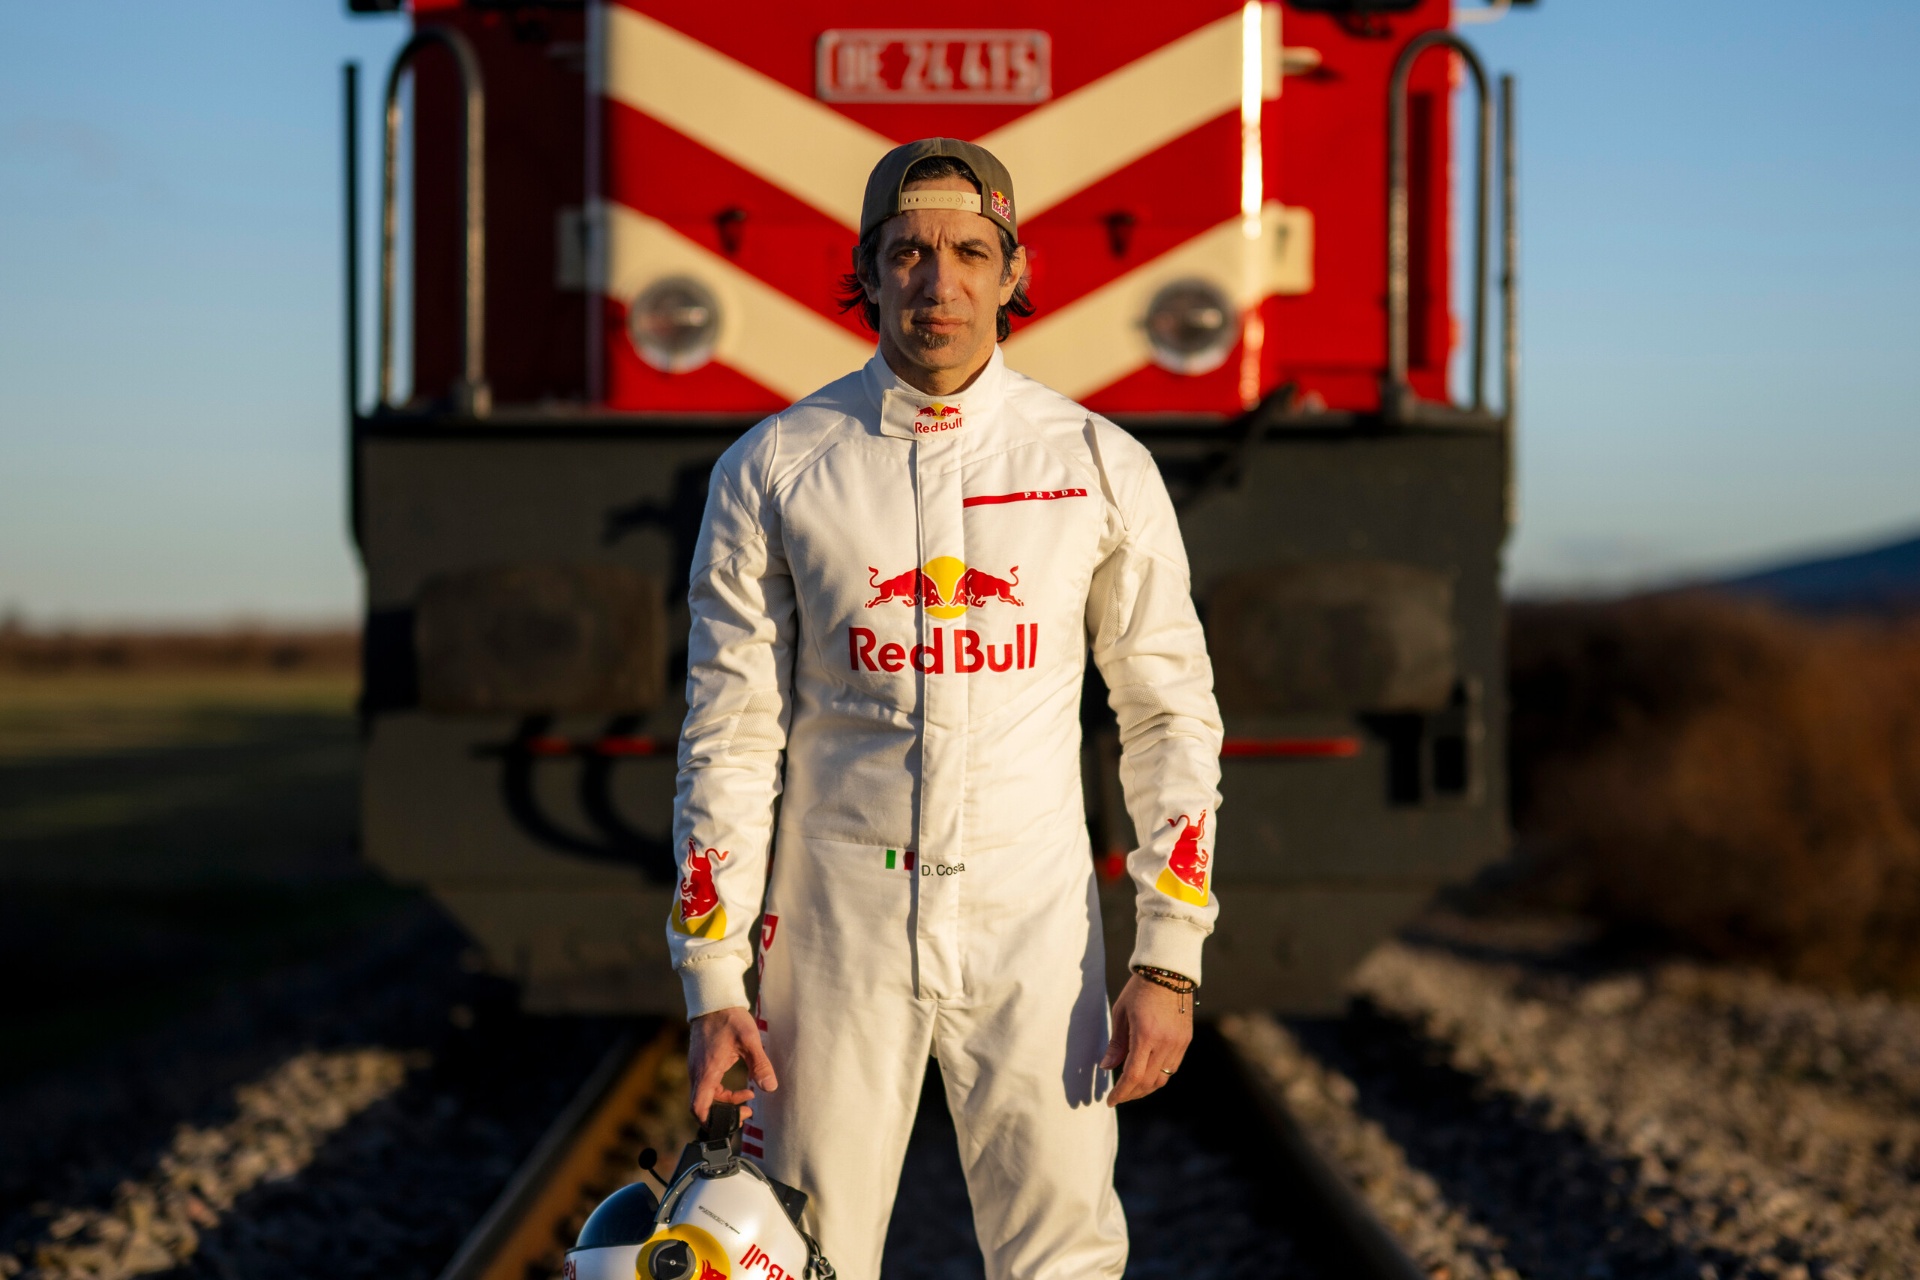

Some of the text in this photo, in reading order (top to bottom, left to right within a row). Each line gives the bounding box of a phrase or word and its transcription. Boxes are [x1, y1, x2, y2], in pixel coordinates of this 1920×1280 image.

[915, 417, 962, 433] Red Bull
[1024, 488, 1081, 499] PRADA
[849, 623, 1038, 675] Red Bull
[921, 864, 934, 876] D.
